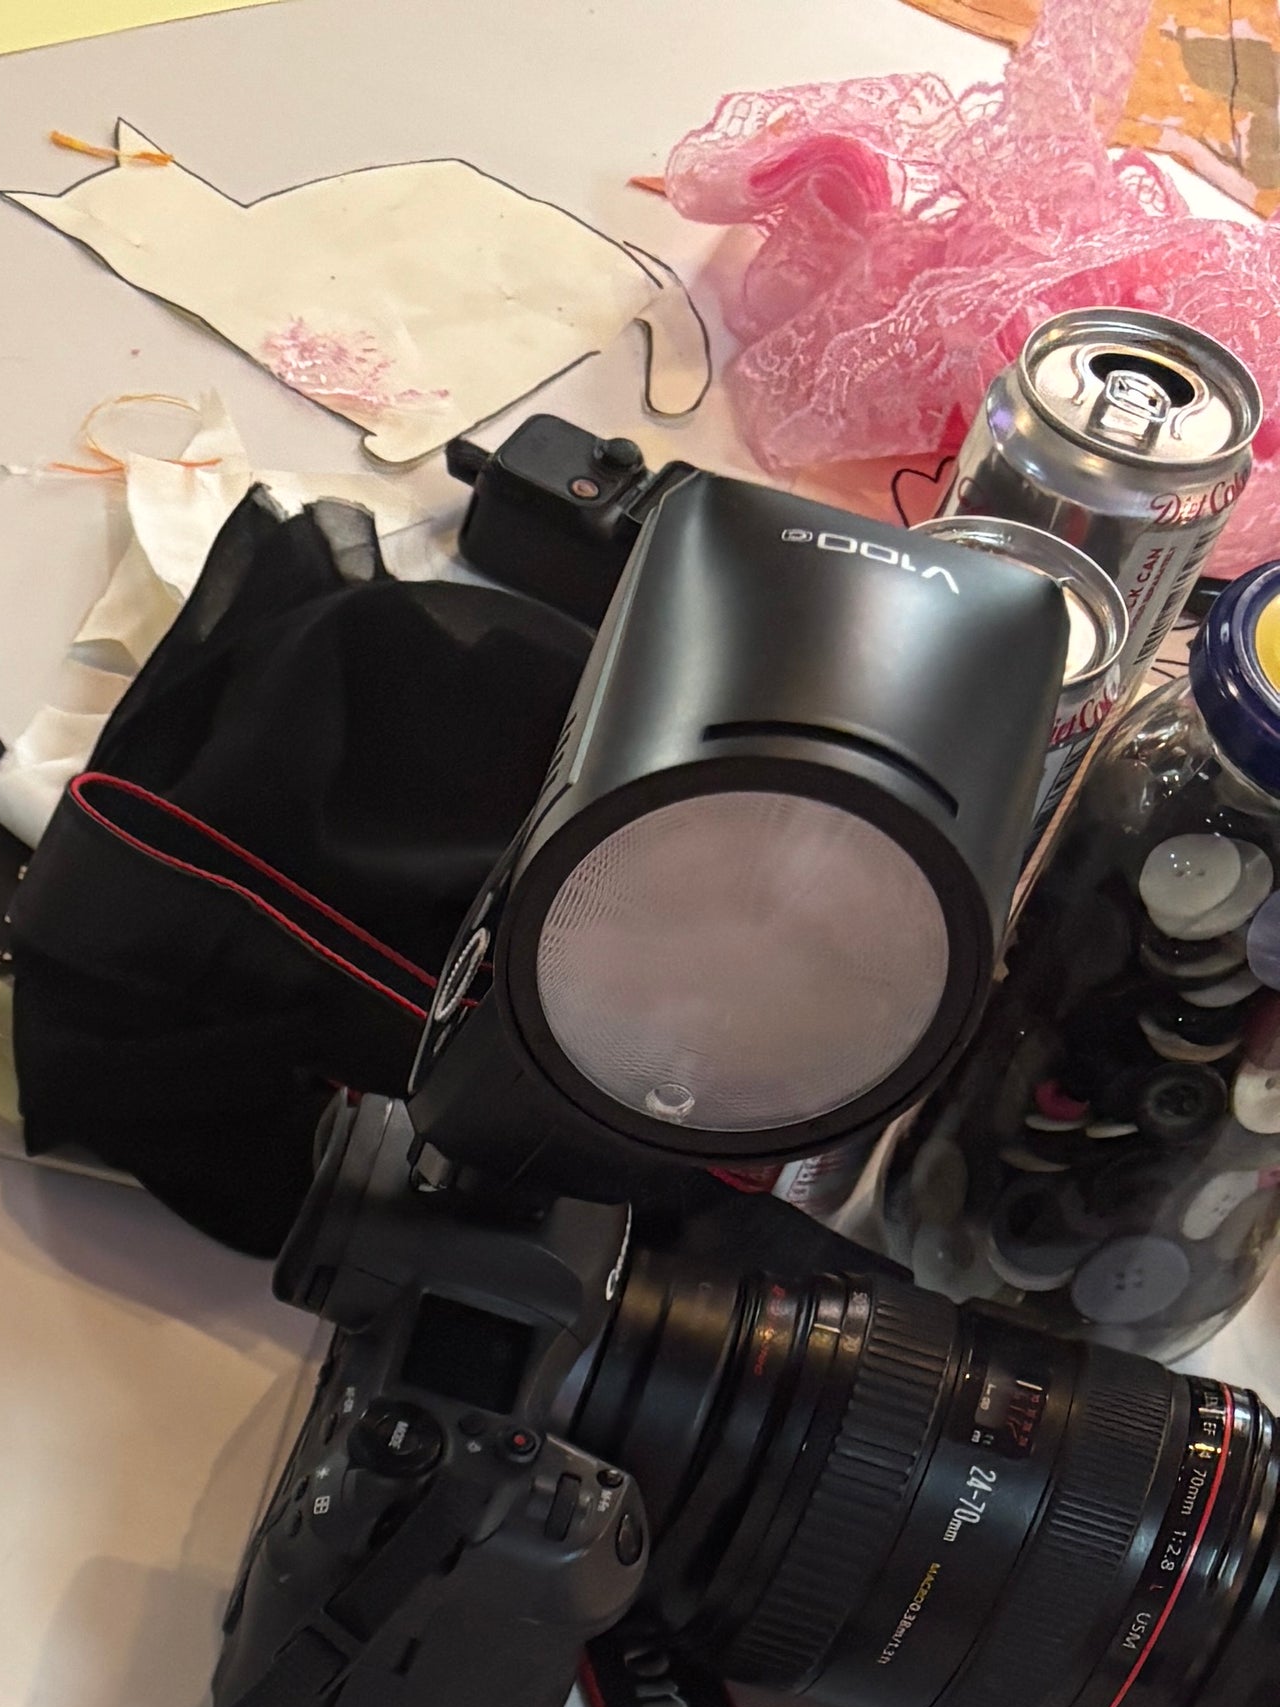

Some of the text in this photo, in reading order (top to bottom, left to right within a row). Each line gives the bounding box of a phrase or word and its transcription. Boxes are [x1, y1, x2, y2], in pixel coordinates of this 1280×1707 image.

[1137, 547, 1165, 583] CAN
[1048, 713, 1078, 746] iet
[943, 1464, 998, 1543] 24-70mm
[1160, 1530, 1187, 1572] 1:2.8
[1122, 1611, 1151, 1650] USM
